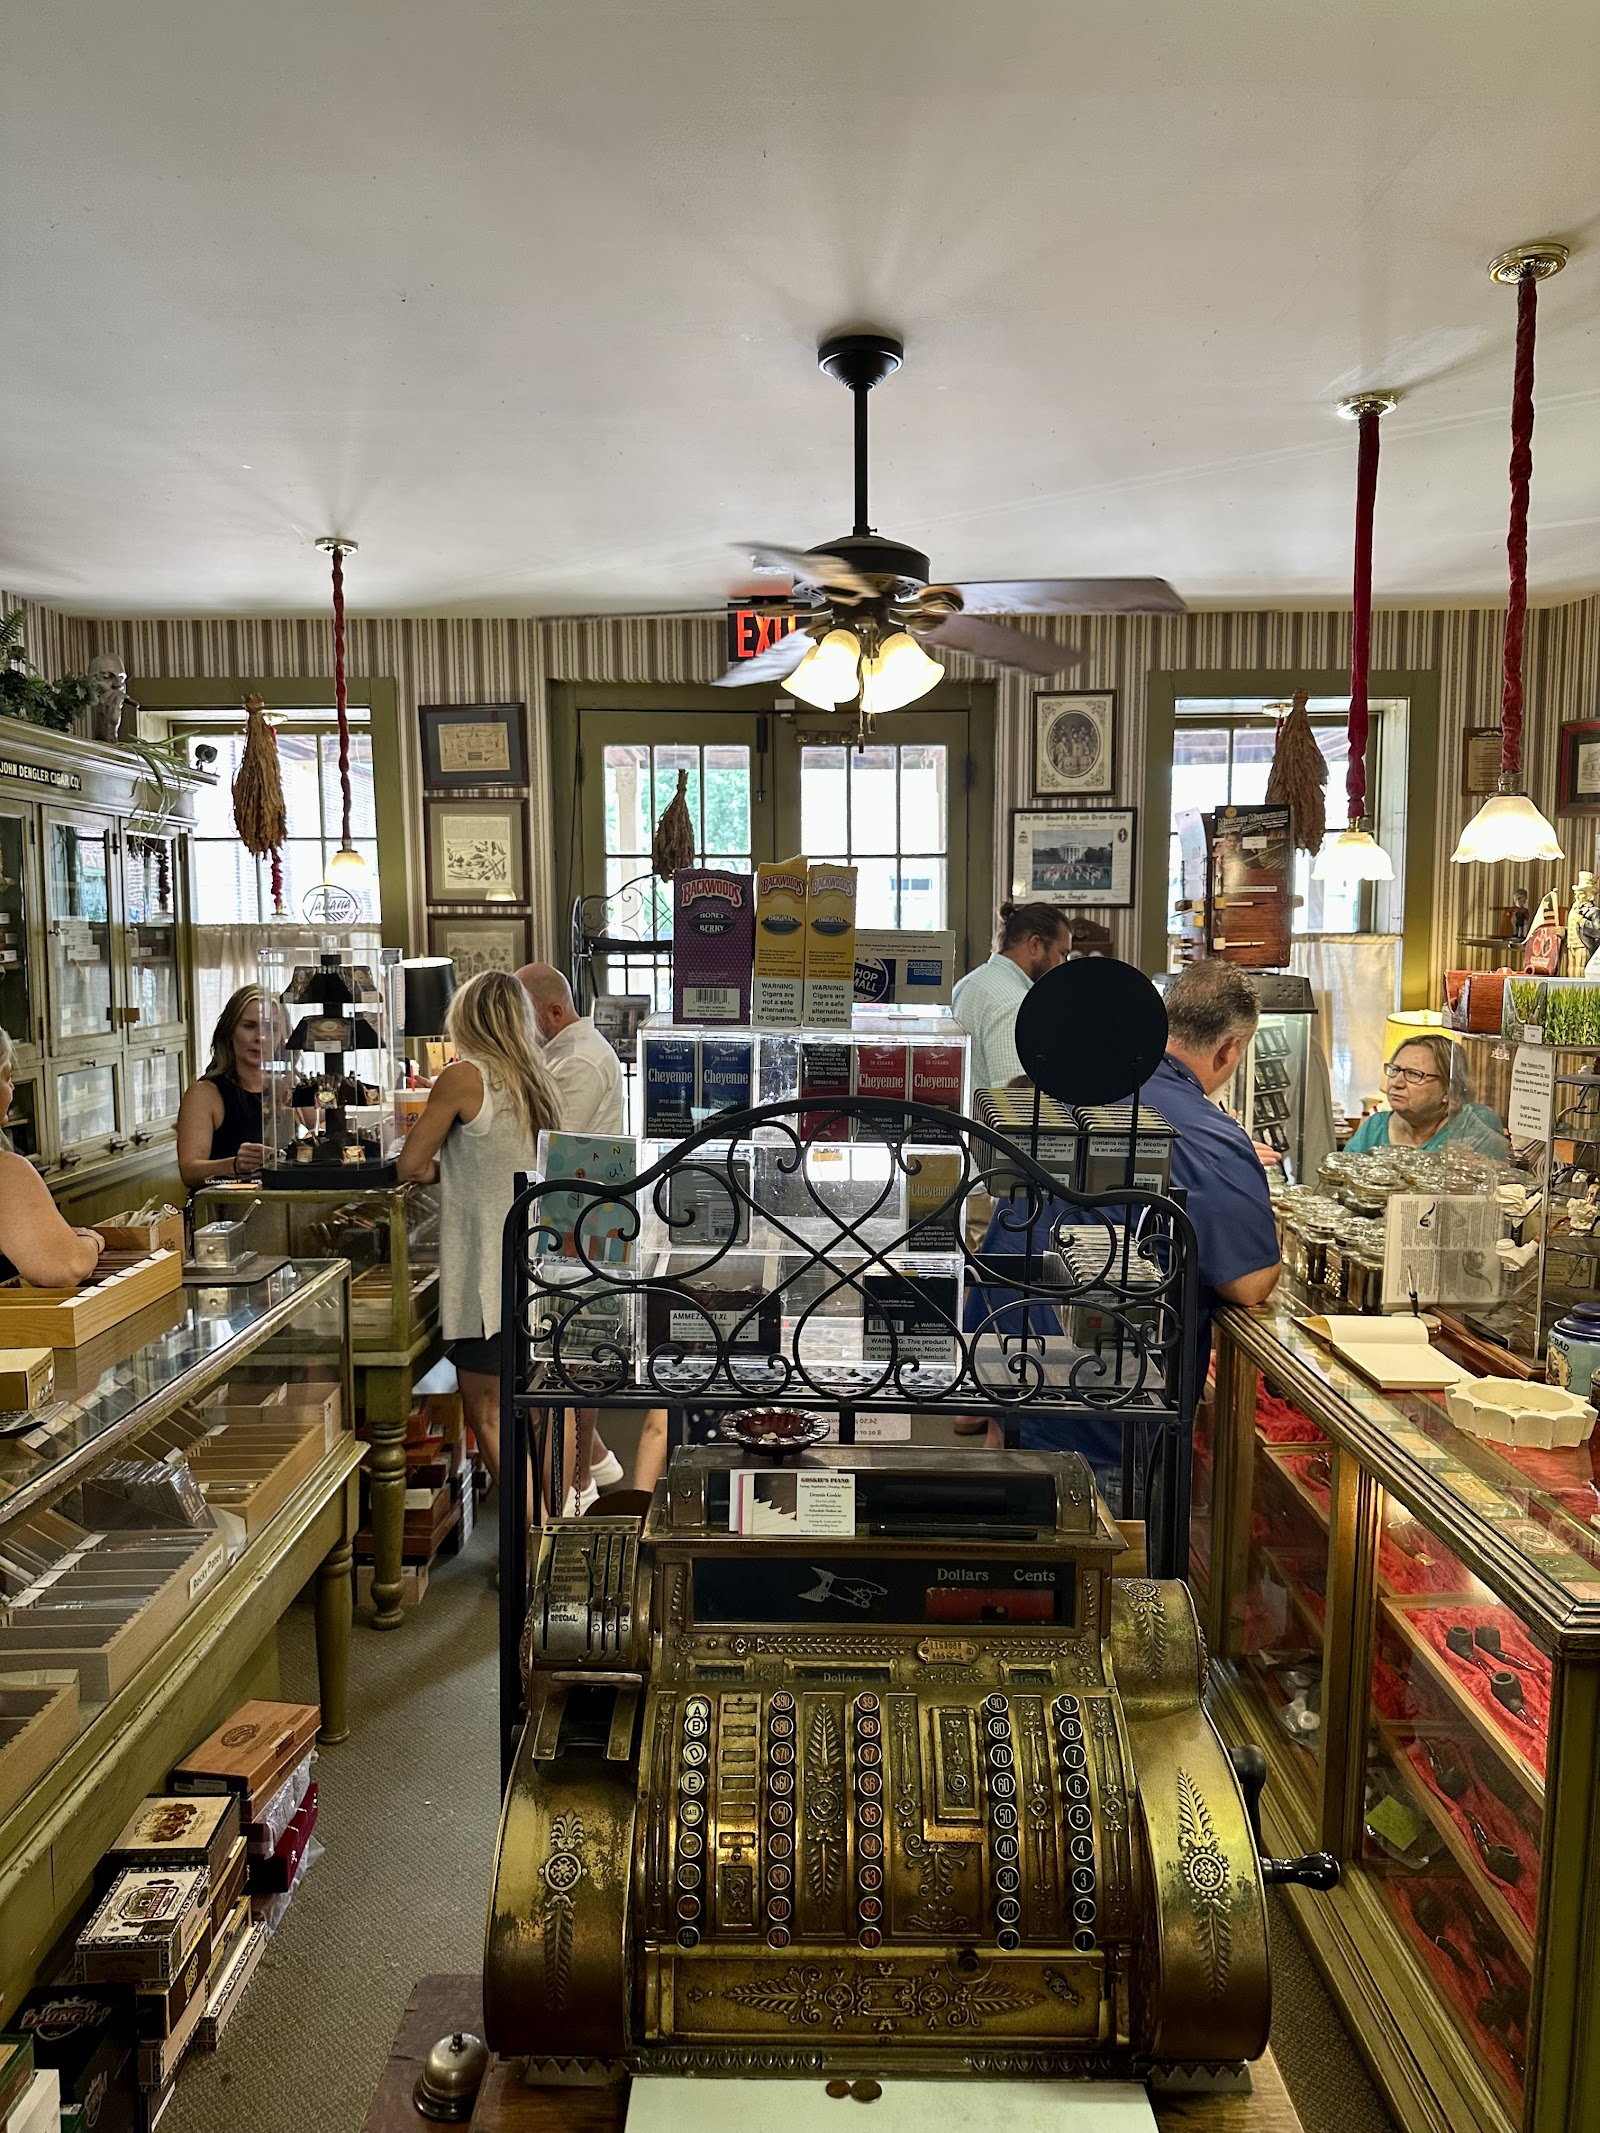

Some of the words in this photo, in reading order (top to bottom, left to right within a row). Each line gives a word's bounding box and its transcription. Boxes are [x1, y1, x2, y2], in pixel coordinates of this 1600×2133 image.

[0, 761, 18, 776] JOHN
[19, 764, 49, 782] DENGLER
[50, 772, 70, 786] CIGAR
[762, 875, 804, 895] BACKWOODS
[811, 875, 854, 896] BACKWOODS
[682, 878, 742, 907] BACKWOODS
[855, 968, 878, 981] HOP
[648, 1068, 692, 1084] Cheyenne
[704, 1069, 748, 1086] Cheyenne
[859, 1073, 903, 1089] Cheyenne
[914, 1073, 959, 1089] Cheyenne
[937, 1568, 989, 1581] Dollars
[1013, 1569, 1056, 1582] Cents
[551, 1614, 578, 1622] SPECIAL
[823, 1672, 863, 1683] Dollars
[776, 1696, 789, 1706] $90
[863, 1697, 873, 1707] $9
[991, 1698, 1002, 1708] 90
[1064, 1699, 1071, 1710] 9
[694, 1706, 701, 1715] A
[692, 1721, 700, 1730] B
[775, 1721, 788, 1731] $80
[863, 1722, 874, 1732] $8
[993, 1722, 1005, 1732] 80
[1068, 1723, 1074, 1734] 8
[690, 1747, 700, 1760] D
[775, 1748, 789, 1760] $70
[864, 1749, 874, 1761] $7
[996, 1750, 1007, 1763] 70
[1071, 1750, 1078, 1763] 7
[688, 1777, 696, 1789] E
[775, 1776, 789, 1789] $60
[864, 1778, 875, 1791] $6
[998, 1778, 1009, 1792] 60
[1074, 1780, 1080, 1794] 6
[774, 1807, 788, 1821] $50
[865, 1807, 876, 1821] $5
[1000, 1809, 1011, 1824] 50
[1076, 1810, 1083, 1824] 5
[865, 1839, 876, 1853] $4
[1001, 1841, 1012, 1856] 40
[1078, 1841, 1084, 1855] 4
[772, 1870, 787, 1884] $30
[865, 1871, 876, 1884] $3
[1002, 1872, 1013, 1887] 30
[1080, 1872, 1086, 1887] 3
[772, 1901, 786, 1915] $20
[865, 1902, 876, 1916] $2
[1003, 1903, 1014, 1917] 20
[1081, 1903, 1087, 1918] 2
[771, 1932, 785, 1944] $10
[865, 1932, 875, 1944] $1
